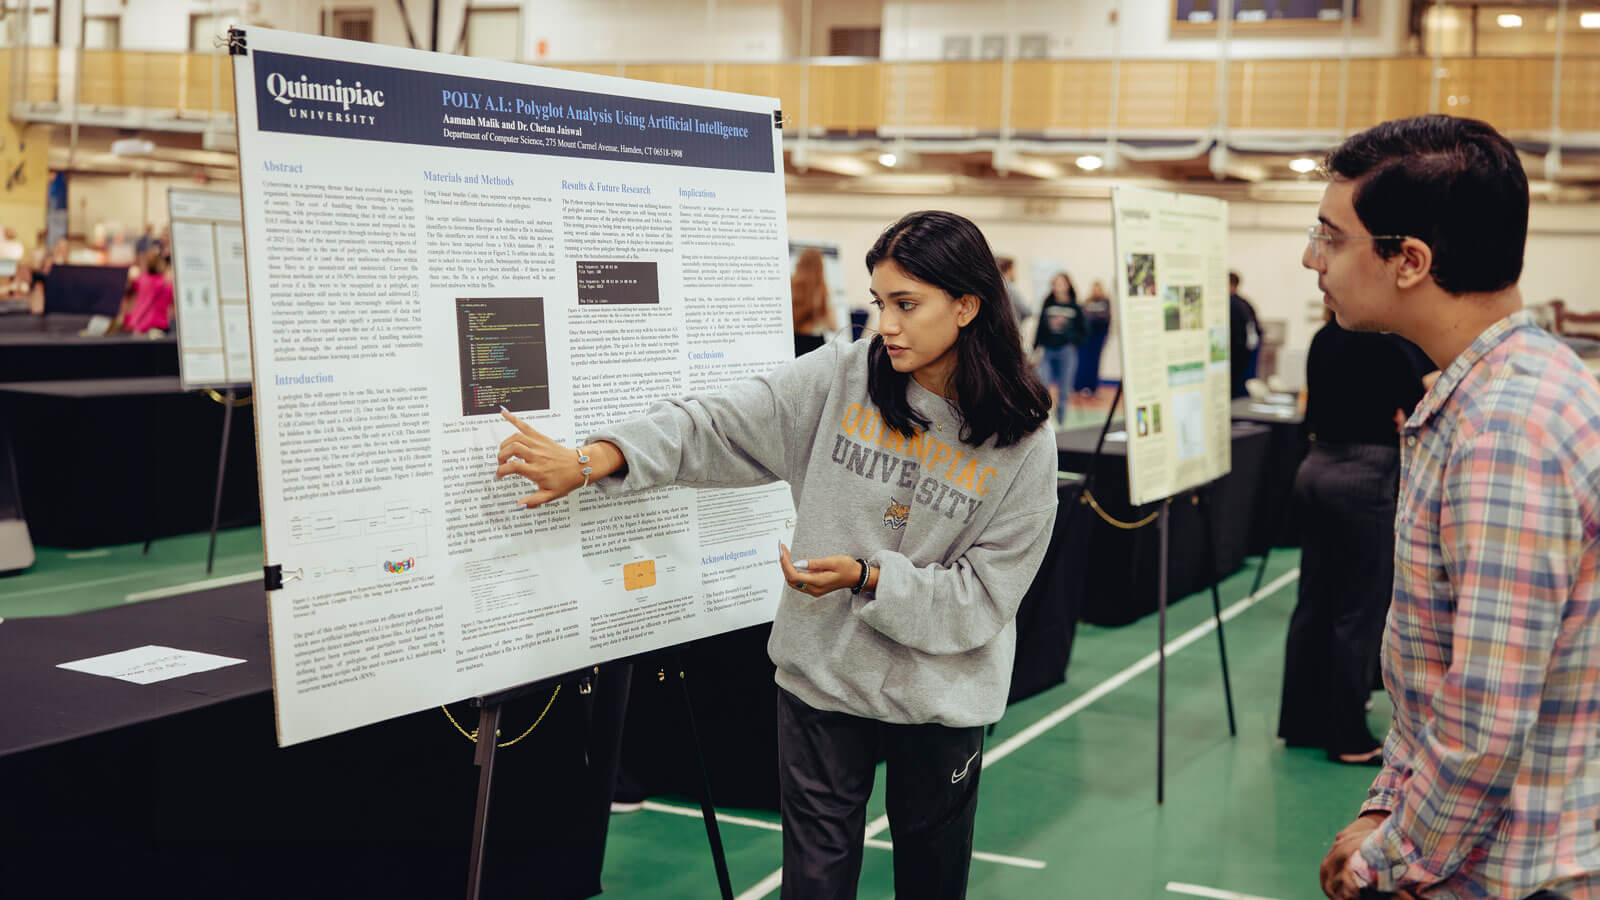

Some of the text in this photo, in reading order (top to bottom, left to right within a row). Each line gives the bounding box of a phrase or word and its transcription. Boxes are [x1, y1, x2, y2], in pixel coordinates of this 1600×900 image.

[266, 72, 384, 110] Quinnipiac
[289, 108, 376, 125] UNIVERSITY
[442, 90, 749, 139] POLY A.I.: Polyglot Analysis Using Artificial Intelligence
[443, 114, 582, 136] Aamnah Malik and Dr. Chetan Jaiswal
[444, 128, 480, 140] Department
[482, 132, 488, 140] of
[489, 133, 519, 145] Computer
[520, 136, 544, 146] Science,
[546, 138, 556, 146] 275
[558, 138, 576, 148] Mount
[577, 141, 597, 151] Carmel
[598, 143, 619, 153] Avenue,
[620, 144, 643, 155] Hamden,
[263, 160, 303, 173] Abstract
[424, 170, 514, 186] Materials and Methods
[562, 180, 651, 194] Results & Future Research
[680, 188, 716, 198] Implications
[688, 350, 724, 360] Conclusions
[274, 373, 334, 385] Introduction
[842, 403, 998, 495] QUINNIPIAC
[832, 434, 983, 524] UNIVESITY
[701, 548, 757, 566] Acknowledgements
